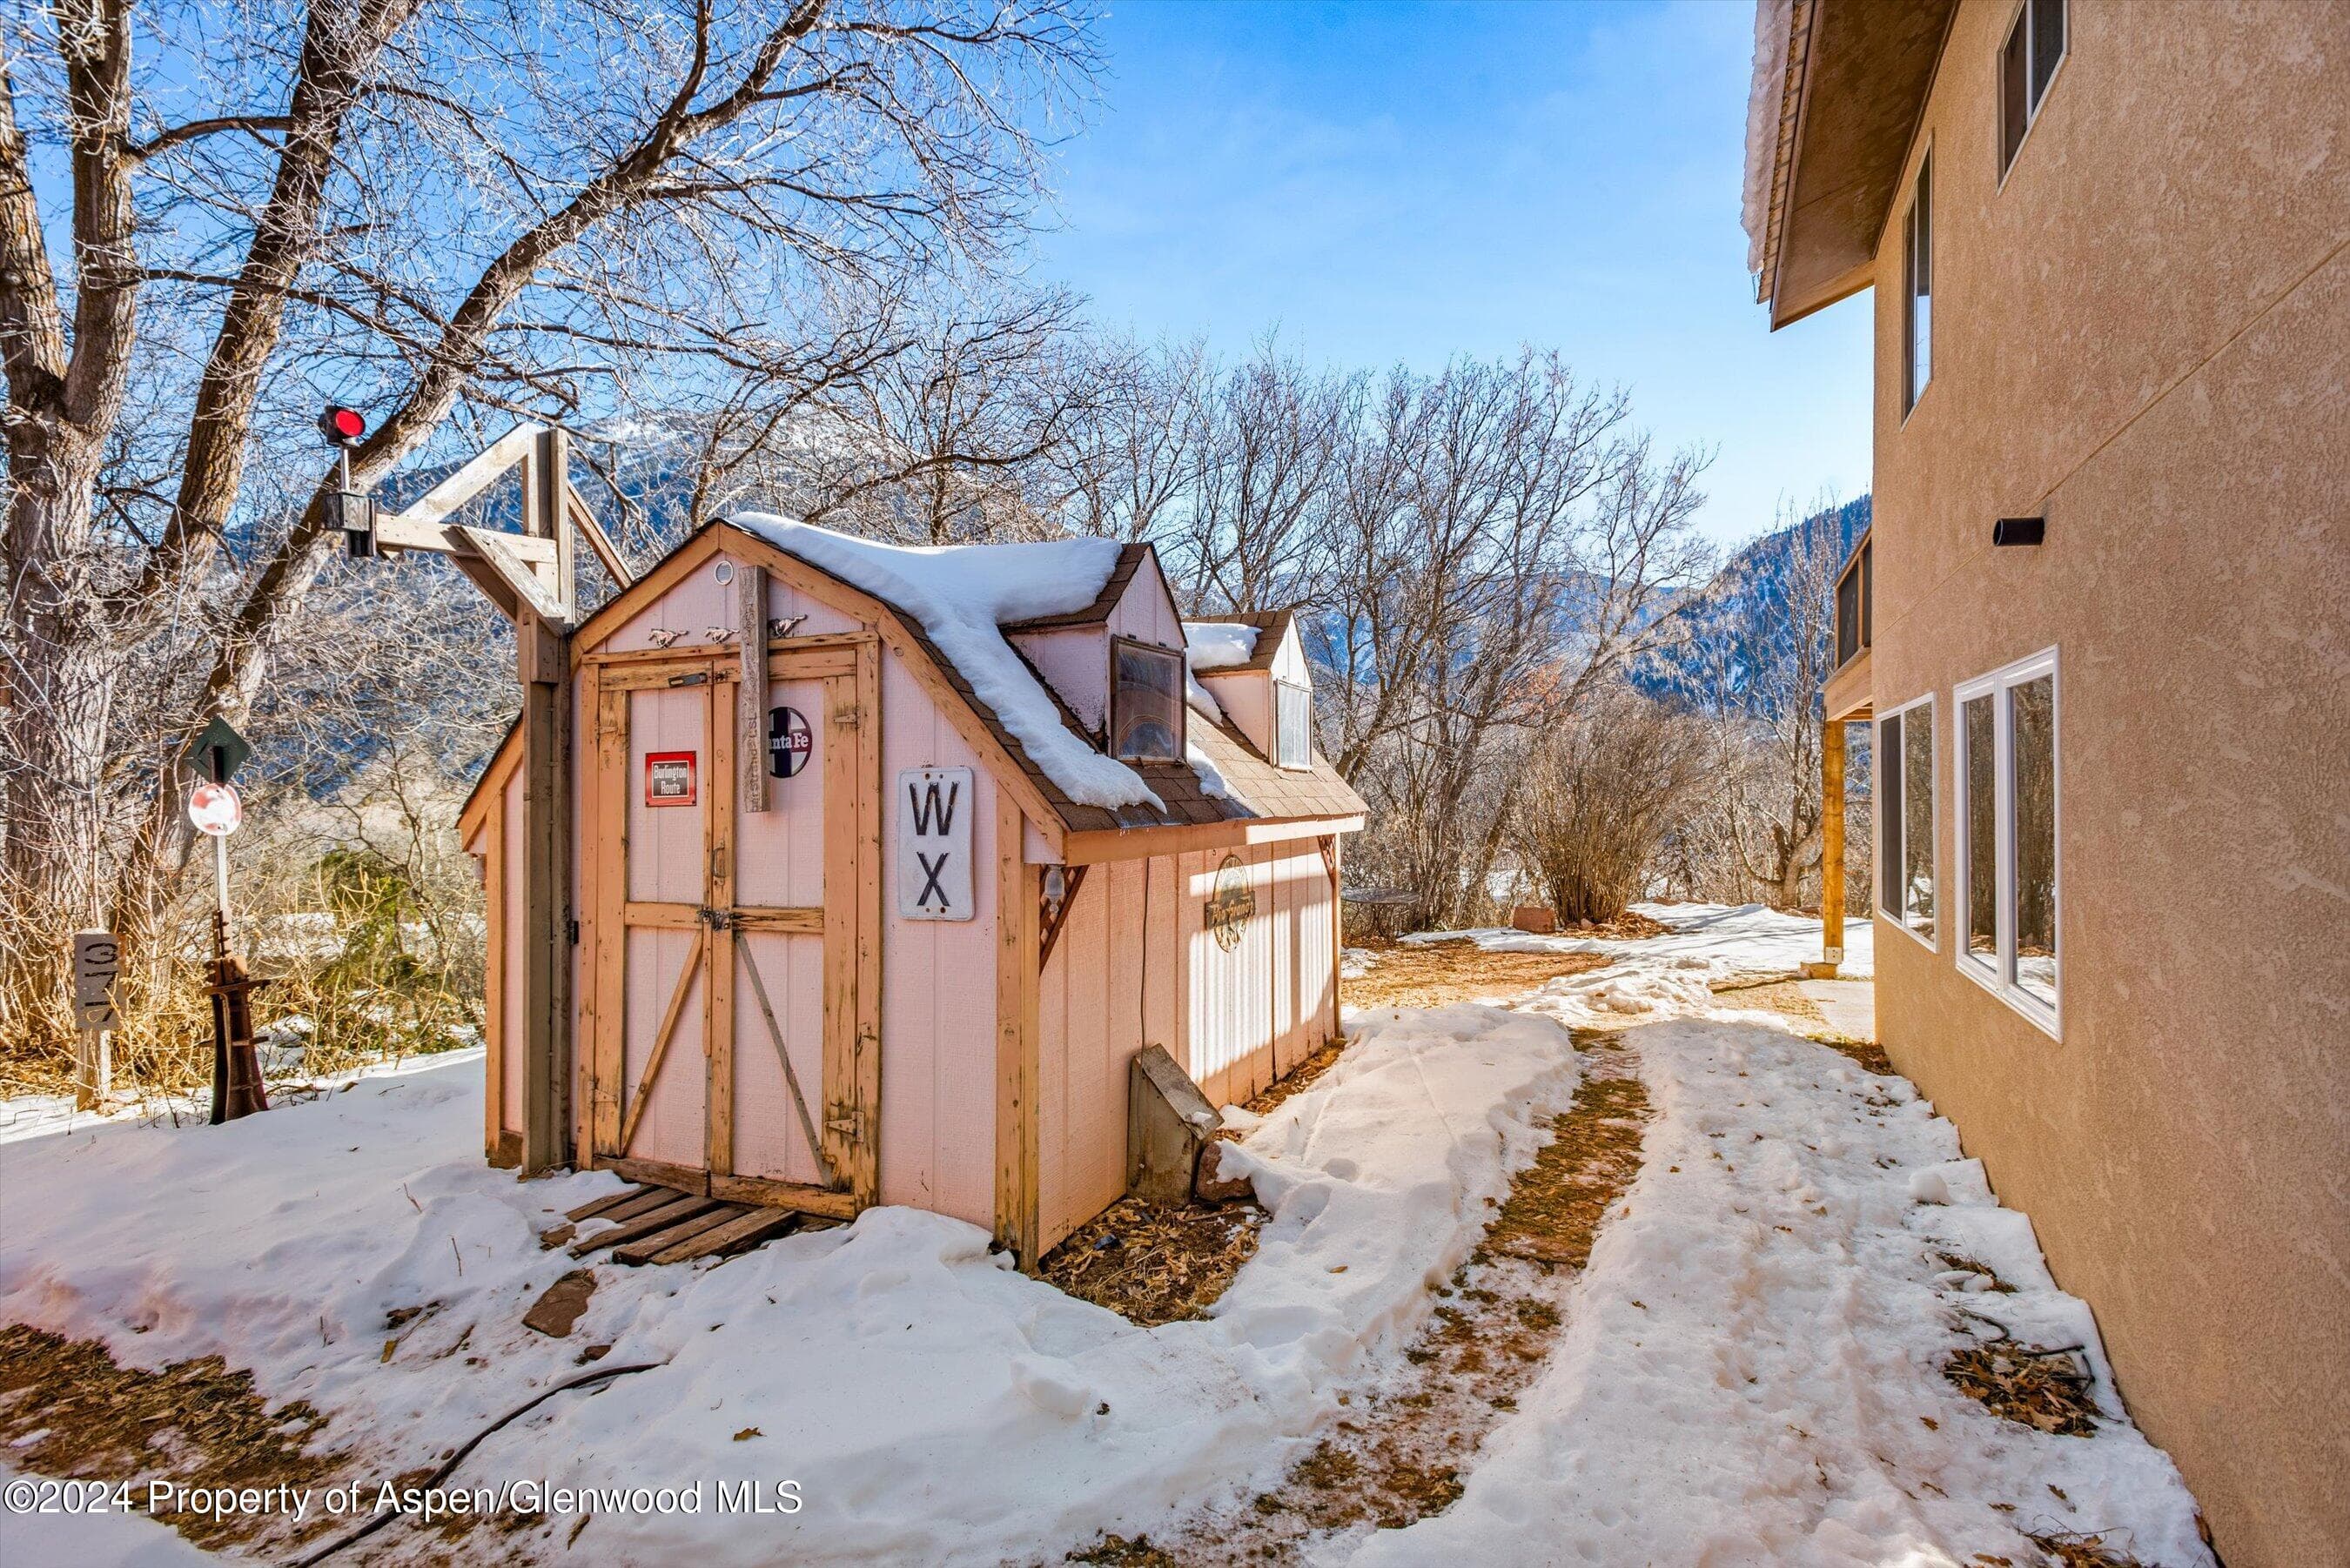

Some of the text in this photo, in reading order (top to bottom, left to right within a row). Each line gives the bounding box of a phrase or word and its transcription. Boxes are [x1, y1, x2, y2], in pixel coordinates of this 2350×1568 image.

[793, 732, 809, 748] Fe
[654, 765, 688, 781] Burlington
[661, 781, 681, 794] Route
